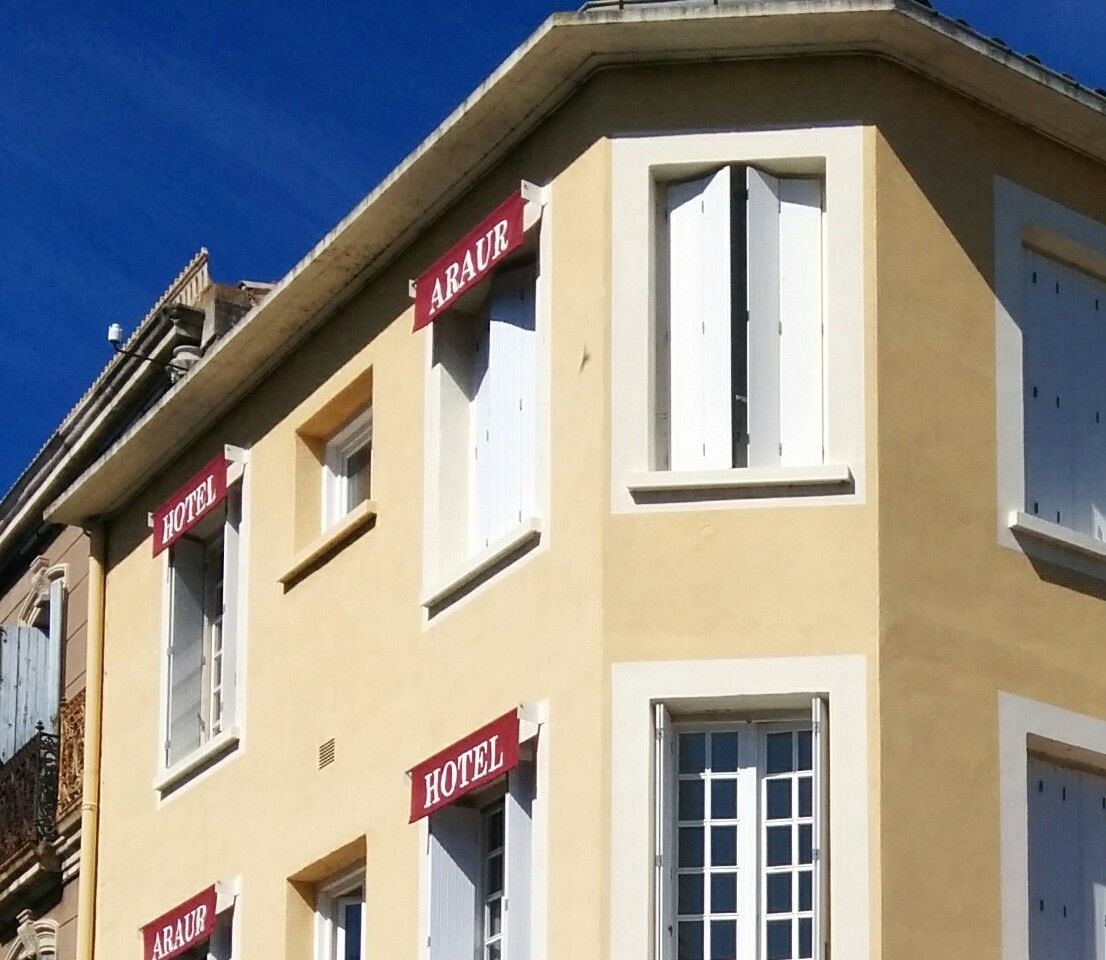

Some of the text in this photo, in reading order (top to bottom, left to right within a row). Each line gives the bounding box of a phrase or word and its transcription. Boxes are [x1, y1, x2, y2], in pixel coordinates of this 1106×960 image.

[429, 219, 509, 315] ARAUR
[162, 475, 217, 545] HOTEL
[424, 734, 504, 809] HOTEL
